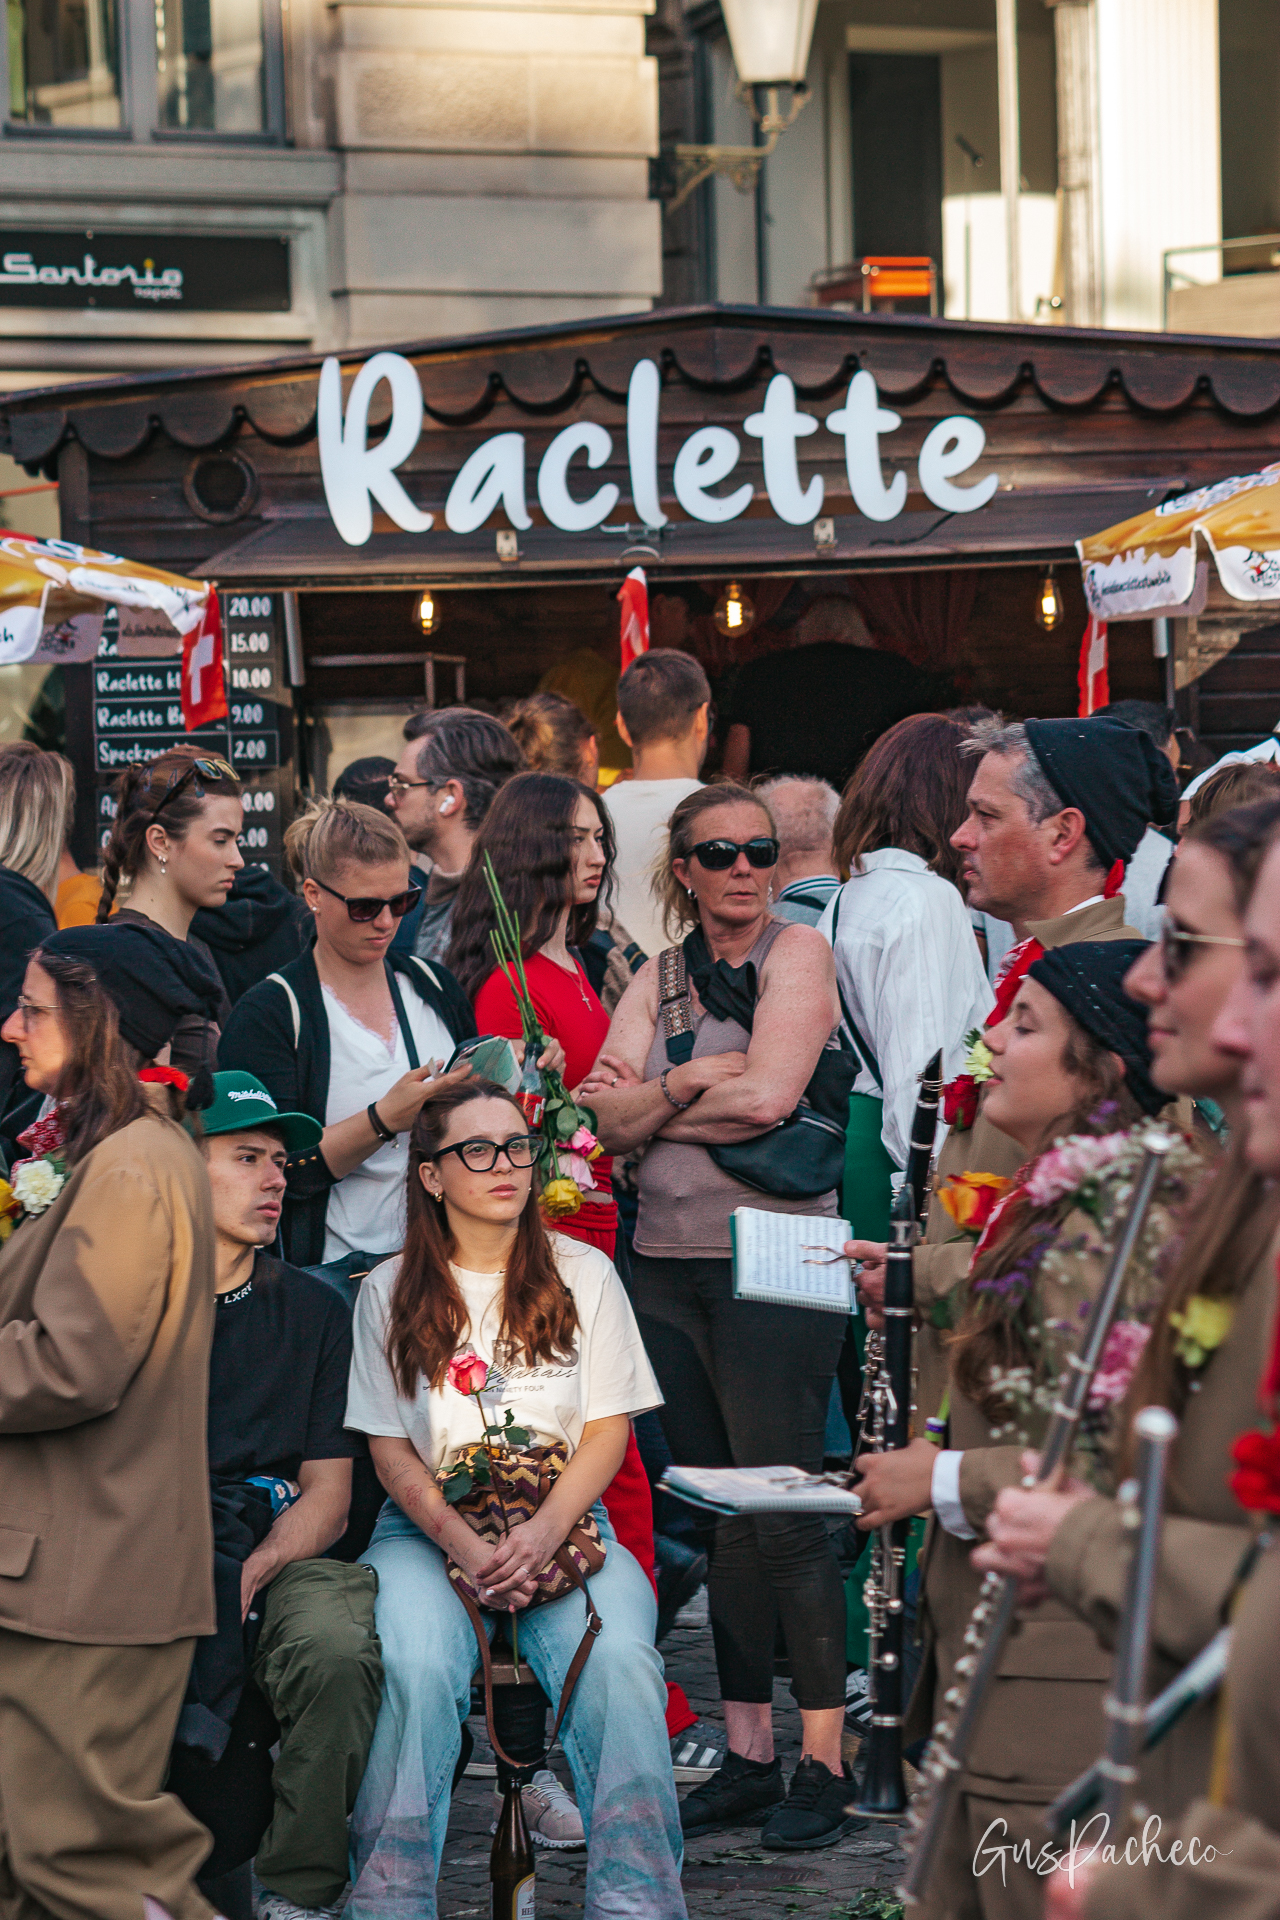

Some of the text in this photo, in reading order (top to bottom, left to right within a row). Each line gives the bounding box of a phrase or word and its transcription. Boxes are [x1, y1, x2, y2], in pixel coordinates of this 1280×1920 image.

[318, 351, 998, 547] Raclette
[229, 596, 271, 617] 20.00
[231, 632, 269, 653] 15.00
[97, 671, 163, 692] Raclette
[232, 667, 271, 688] 10.00
[97, 706, 164, 728] Raclette
[231, 704, 263, 724] 9.00
[234, 739, 266, 760] 2.00
[224, 1281, 252, 1304] LXRY
